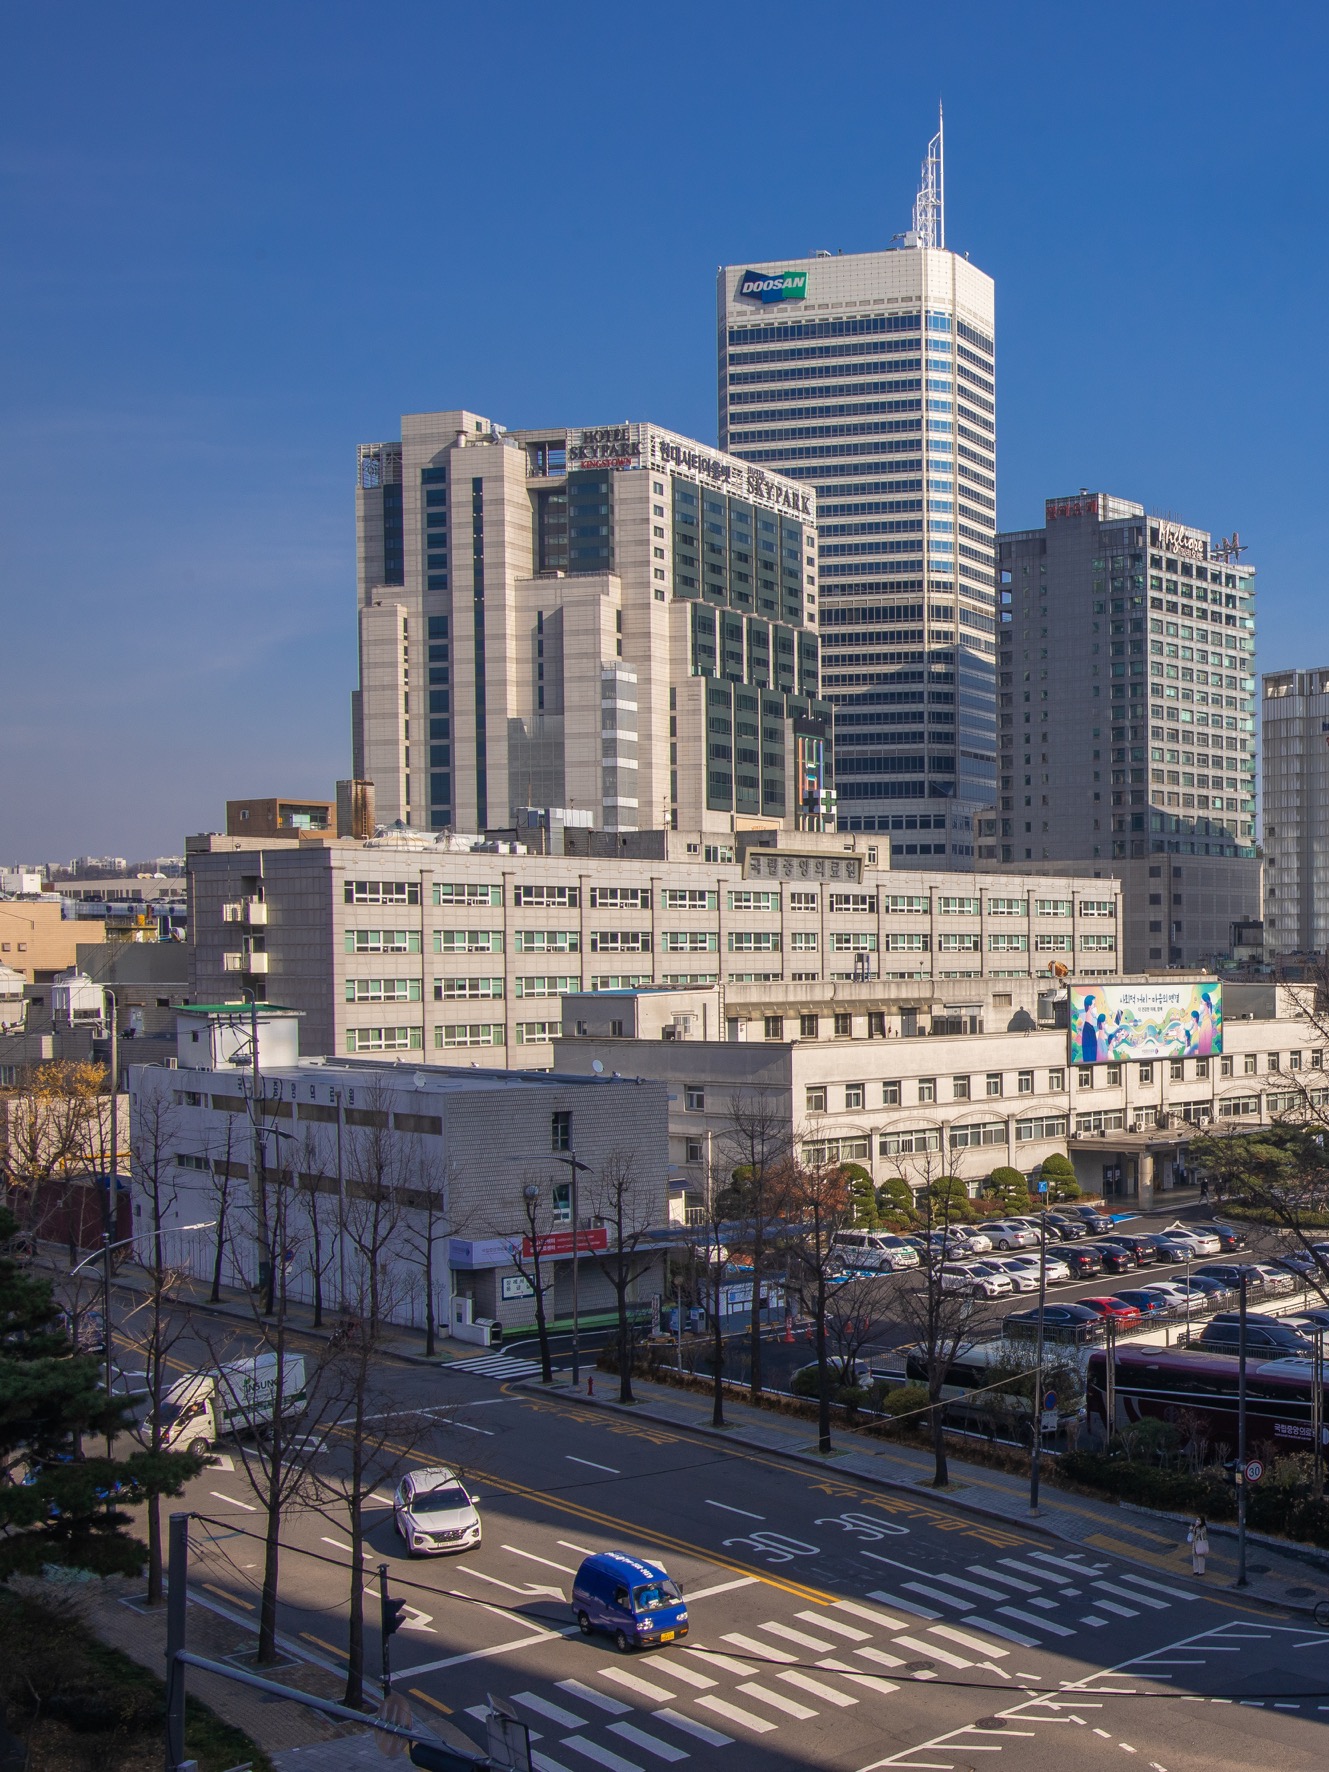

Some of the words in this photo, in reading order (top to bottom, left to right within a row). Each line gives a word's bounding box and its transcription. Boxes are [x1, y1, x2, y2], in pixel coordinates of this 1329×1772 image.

[742, 277, 805, 294] DOOSAN
[583, 429, 630, 444] HOTEL
[569, 441, 642, 460] SKYPARK
[580, 457, 632, 469] KINGSTOWN
[659, 440, 731, 485] 현대시티아울렛
[747, 474, 811, 516] SKYPARK
[1159, 520, 1204, 553] Migliore
[750, 856, 857, 879] 국립중앙의료원
[1249, 1466, 1260, 1477] 30
[814, 1513, 910, 1541] 30
[721, 1531, 820, 1562] 30
